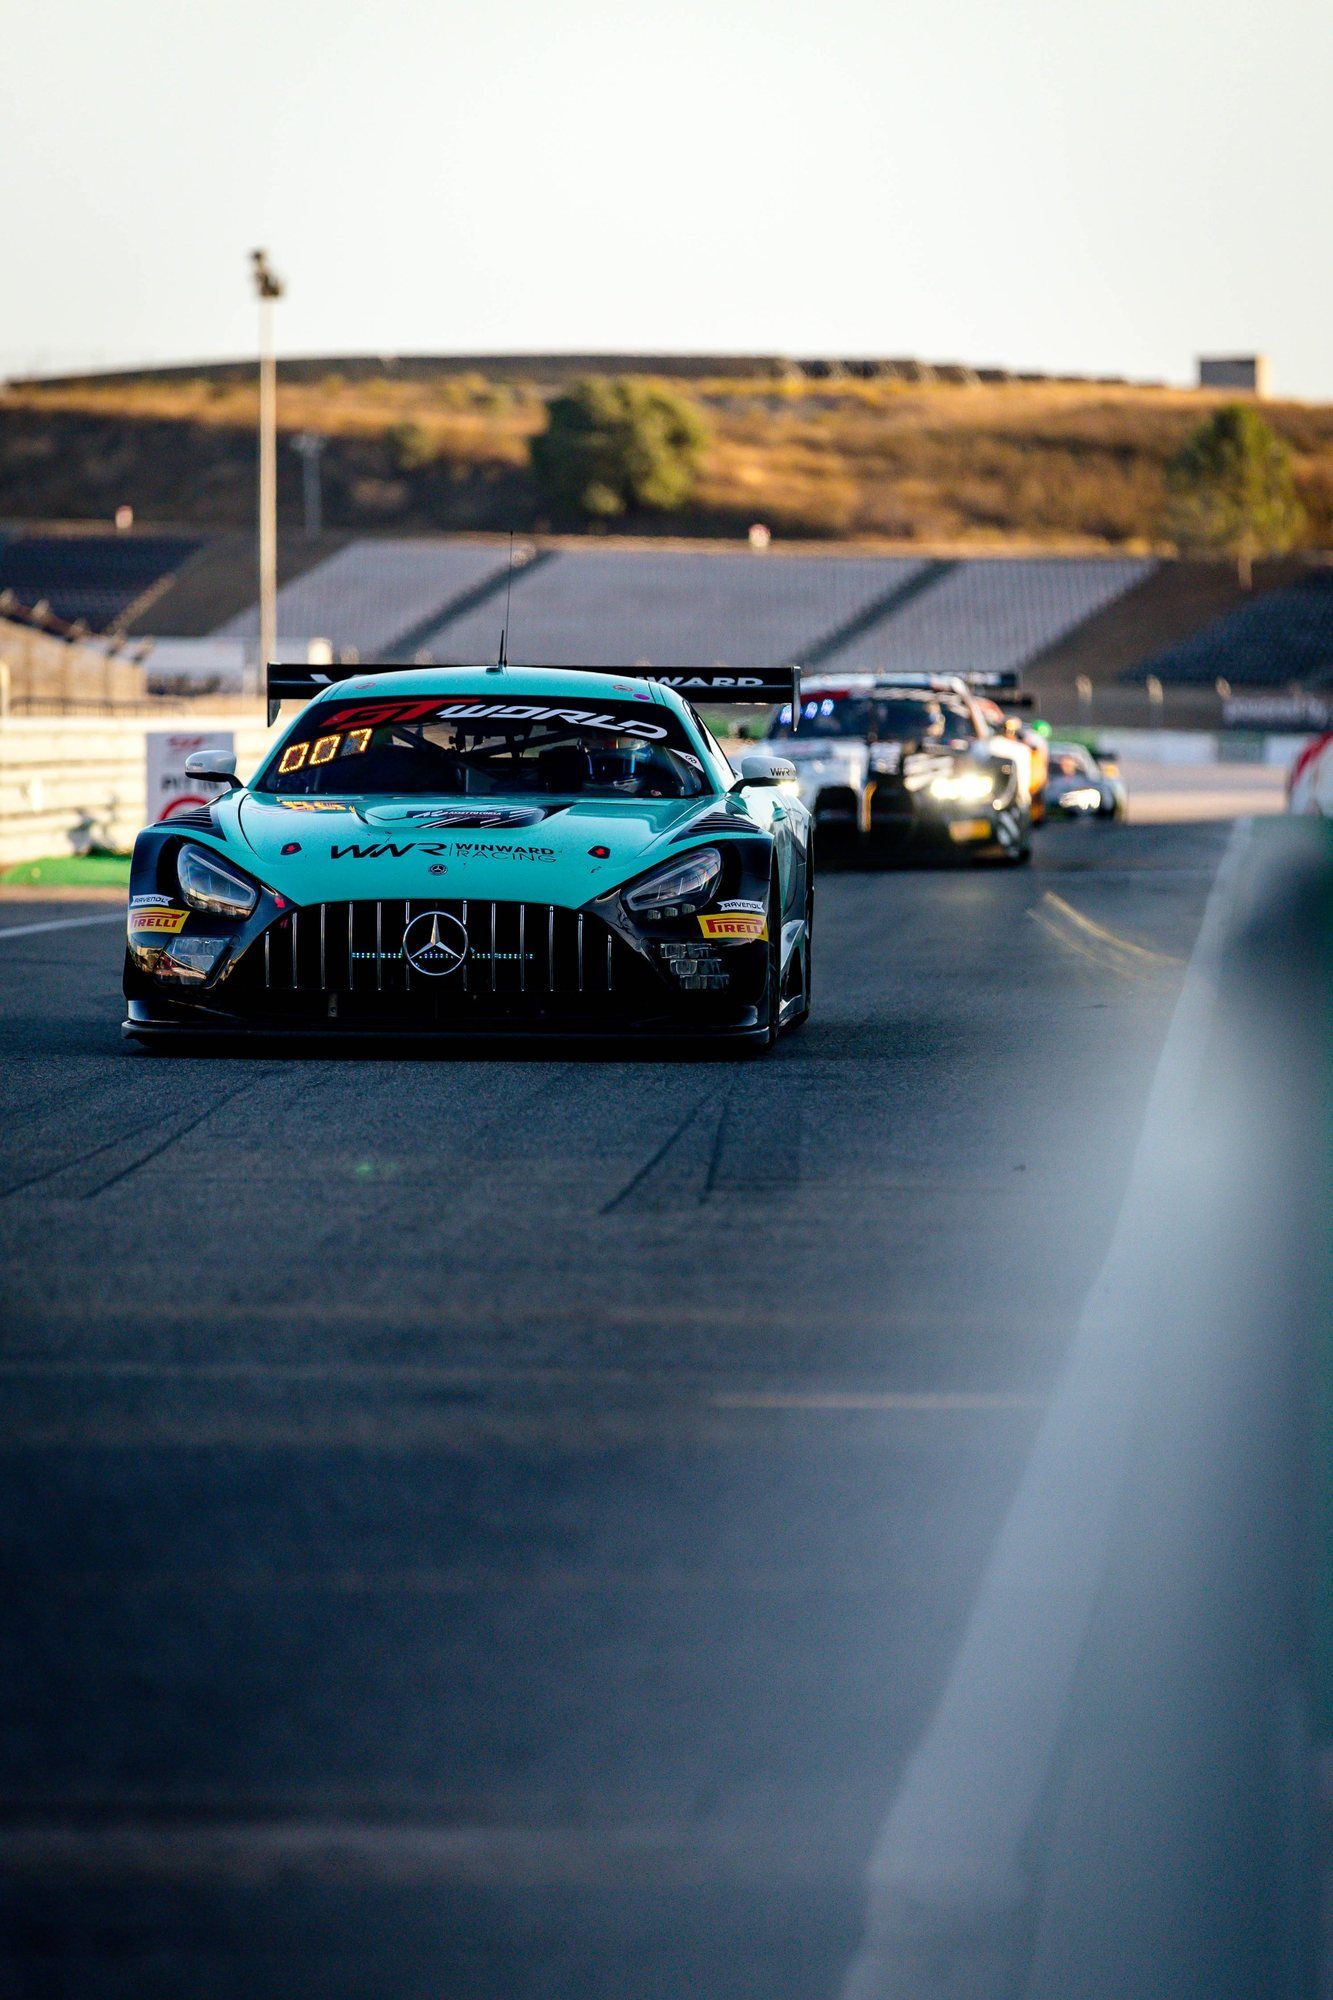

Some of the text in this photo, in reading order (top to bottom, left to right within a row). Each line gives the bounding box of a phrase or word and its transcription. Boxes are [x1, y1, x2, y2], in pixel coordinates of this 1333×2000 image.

[436, 704, 668, 739] WORLD
[278, 728, 374, 774] 007
[455, 842, 554, 856] WINWARD
[456, 849, 557, 863] RACING
[723, 901, 762, 910] RAVENOL
